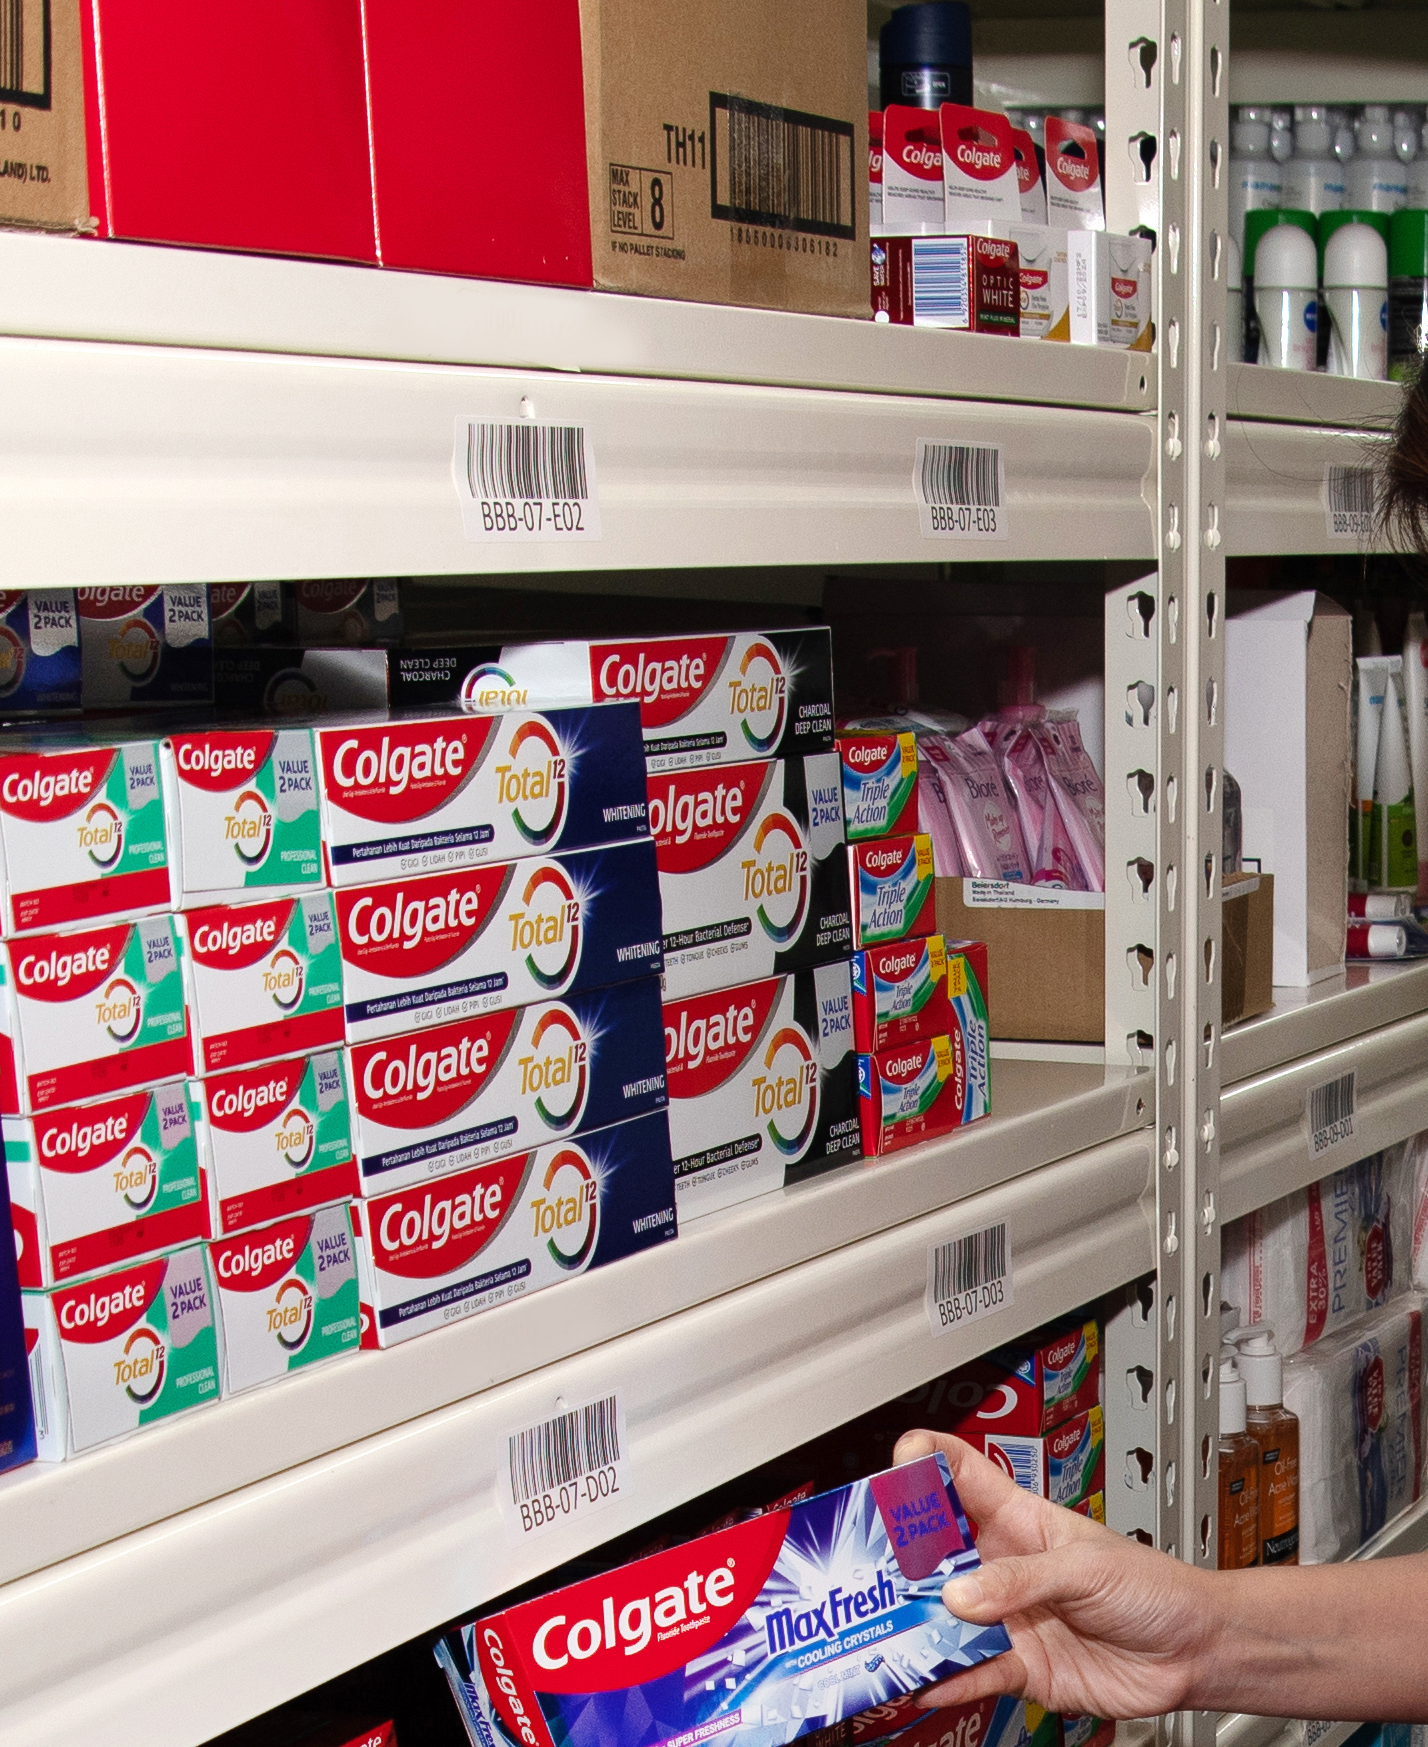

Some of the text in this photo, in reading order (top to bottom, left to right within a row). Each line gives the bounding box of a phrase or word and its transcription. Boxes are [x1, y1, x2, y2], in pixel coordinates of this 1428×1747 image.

[663, 123, 706, 170] TH11
[611, 167, 630, 187] MAX
[612, 189, 639, 210] STACK
[651, 177, 665, 231] 8
[612, 211, 638, 230] LEVEL
[983, 288, 1013, 308] WHITE
[482, 500, 585, 534] BBB-07-E02
[930, 504, 998, 534] BBB-07-E03
[729, 676, 785, 715] Total 12
[799, 703, 831, 719] CHARCOAL
[795, 719, 832, 735] DEEP CLEAN
[129, 763, 153, 777] VALUE
[179, 743, 256, 777] Colgate
[278, 760, 309, 775] VALUE
[333, 734, 467, 795] Colgate
[2, 767, 95, 807] Colgate
[495, 758, 565, 804] Total 12
[861, 781, 890, 802] Triple
[603, 802, 646, 823] WHITENING
[852, 803, 887, 826] Action
[78, 821, 123, 848] Total 12
[224, 814, 272, 840] Total 12
[972, 881, 1010, 891] Beiersdorf
[822, 996, 849, 1016] VALUE
[752, 1062, 817, 1118] Total 12
[829, 1118, 860, 1138] CHARCOAL
[826, 1133, 860, 1154] DEEP CLEAN
[380, 1176, 504, 1250] Colgate
[531, 1181, 597, 1238] Total 12
[632, 1209, 674, 1234] WHITENING
[170, 1278, 203, 1299] VALUE
[938, 1281, 1004, 1327] BBB-07-D03
[114, 1346, 165, 1385] Total 12
[522, 1467, 620, 1533] BBB-07-D02
[889, 1492, 941, 1526] VALUE
[531, 1569, 737, 1670] Colgate
[797, 1620, 895, 1669] COOLING CRYSTALS
[694, 1713, 740, 1741] FRESHNESS
